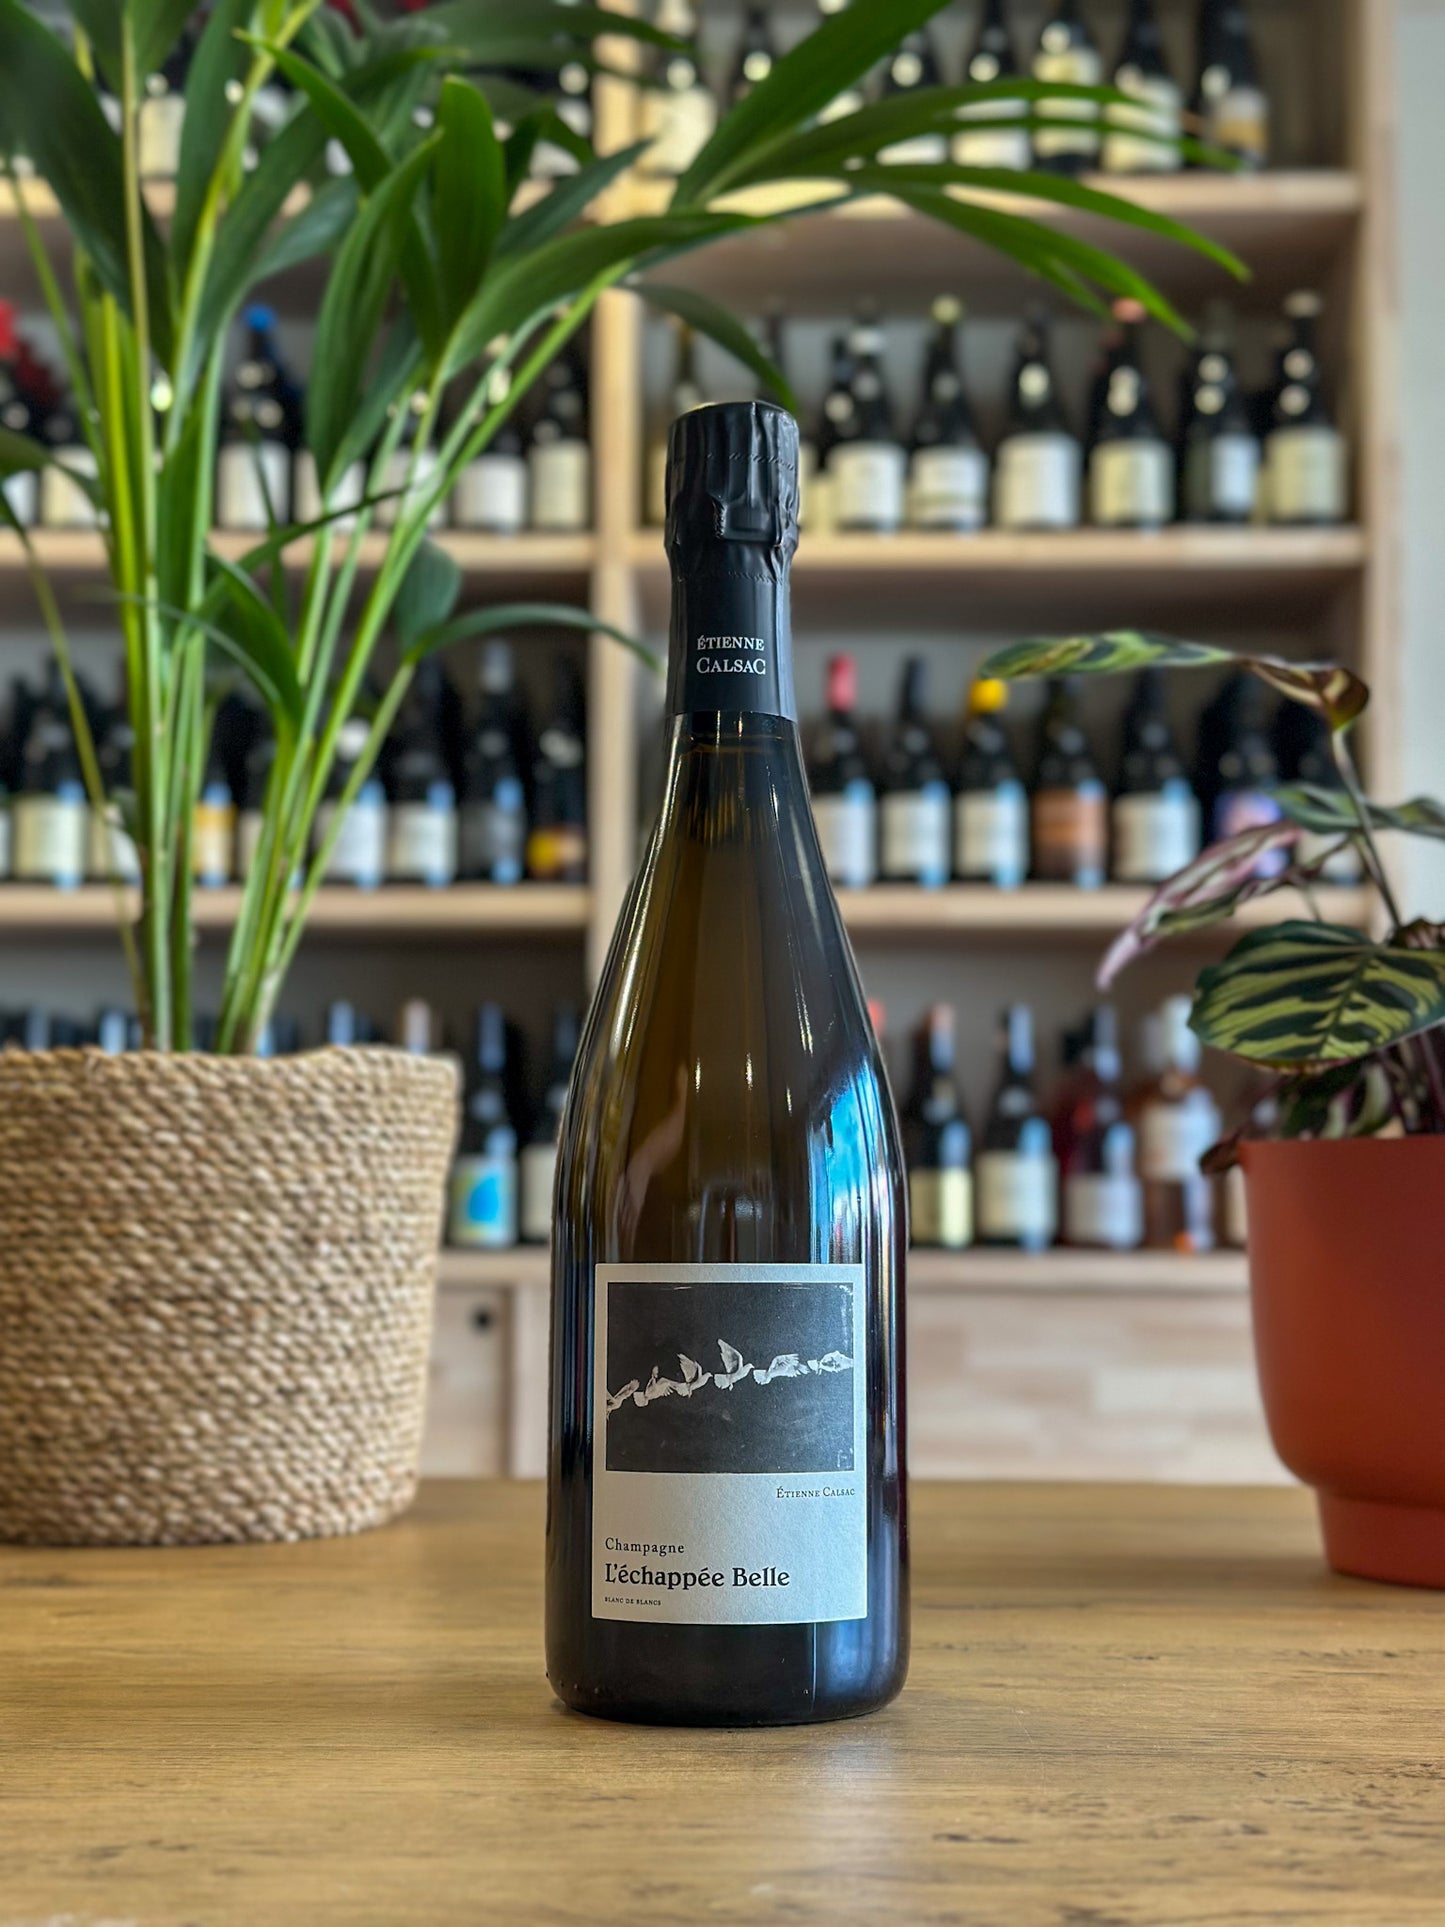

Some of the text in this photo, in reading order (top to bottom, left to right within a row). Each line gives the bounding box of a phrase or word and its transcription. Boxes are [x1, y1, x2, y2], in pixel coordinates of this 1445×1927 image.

[697, 634, 765, 651] ÉTIENNE
[696, 657, 766, 675] CALSAC
[776, 1486, 855, 1498] ÉTIENNE CALSAC
[605, 1537, 685, 1556] Champagne
[732, 1567, 790, 1587] Belle
[604, 1596, 624, 1604] BLANC
